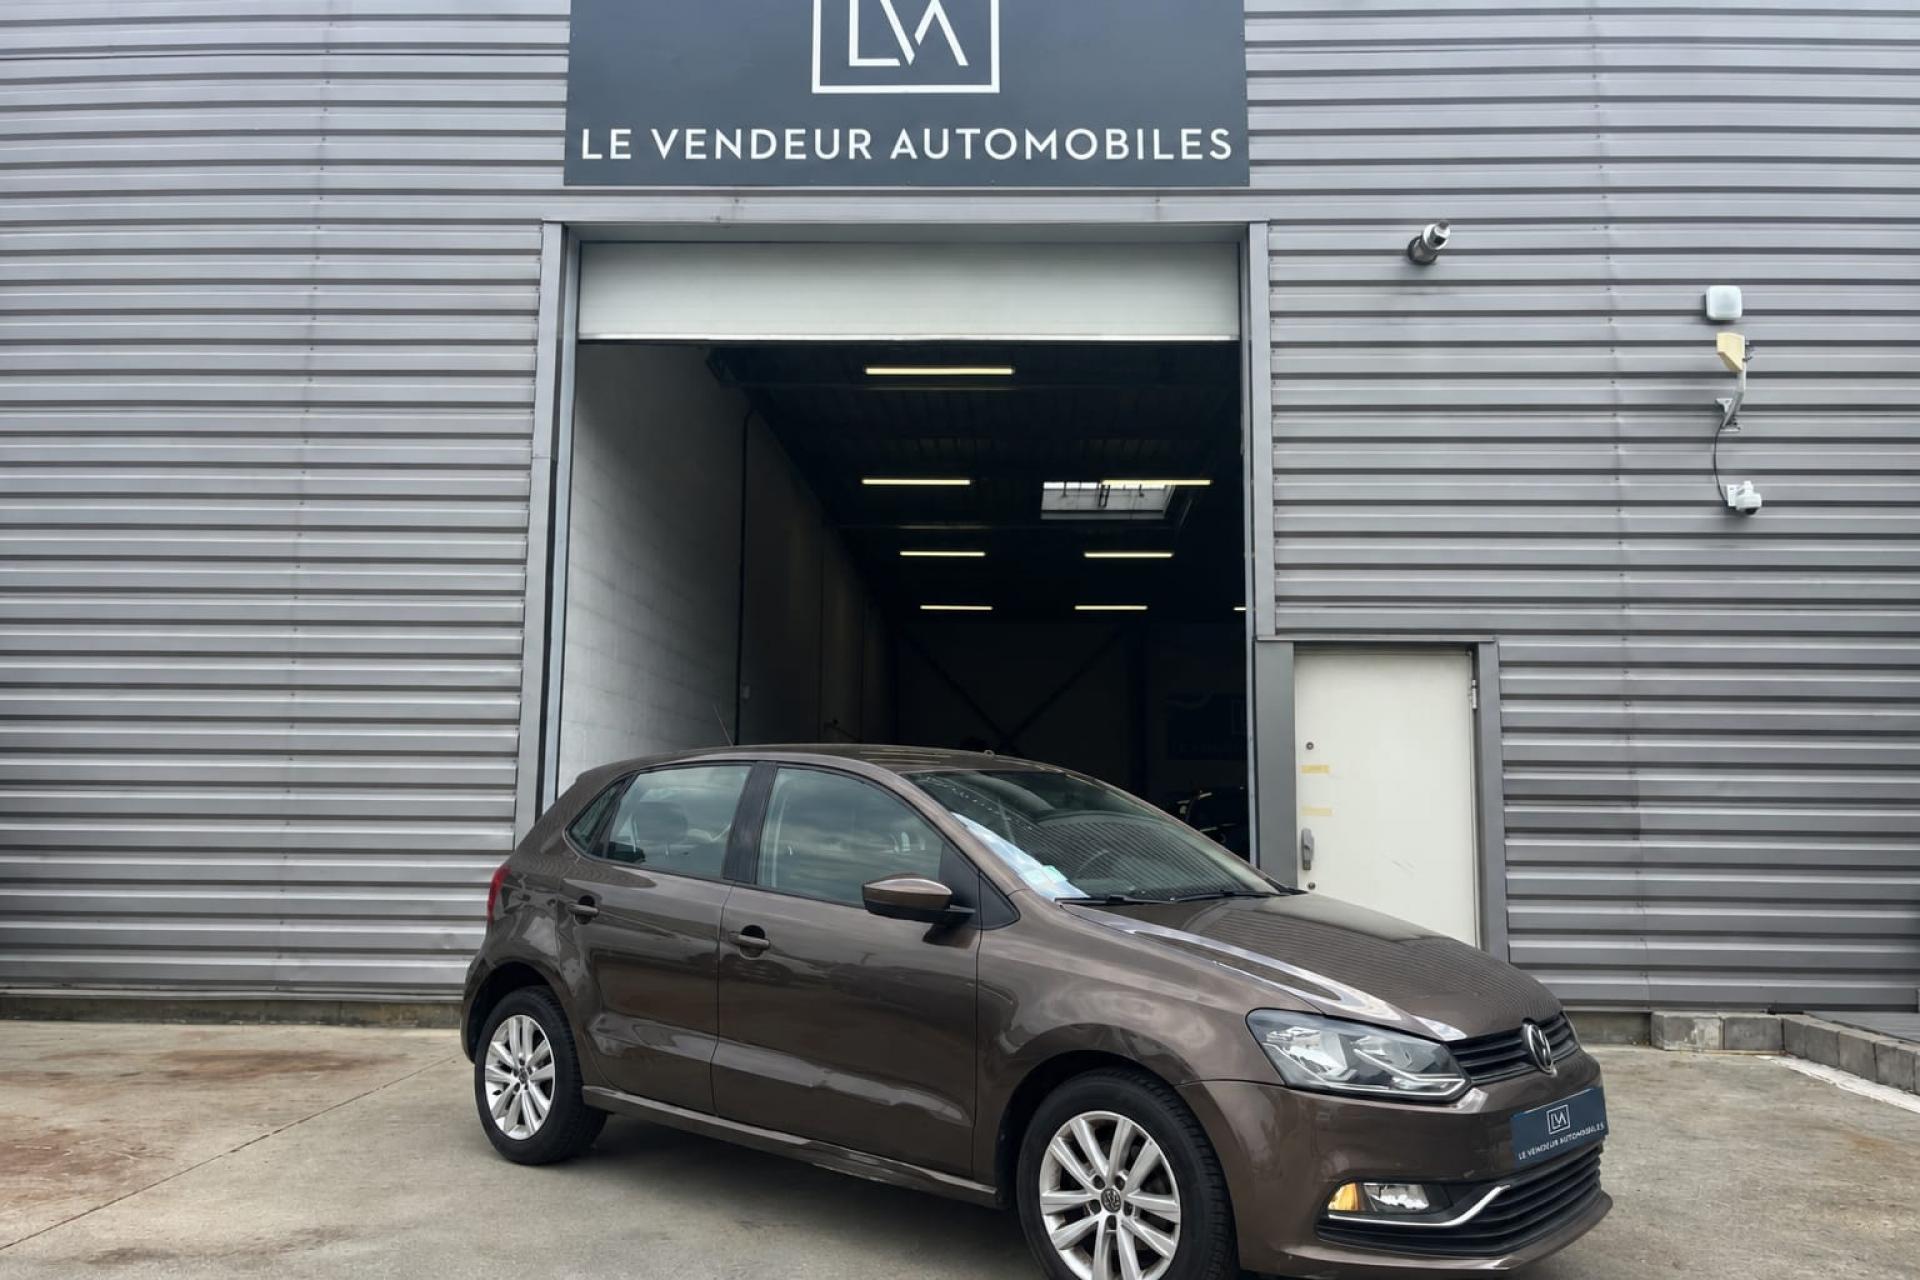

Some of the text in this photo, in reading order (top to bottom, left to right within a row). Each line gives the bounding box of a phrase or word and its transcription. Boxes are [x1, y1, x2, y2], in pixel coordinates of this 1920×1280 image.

[582, 126, 1232, 162] LE VENDEUR AUTOMOBILES
